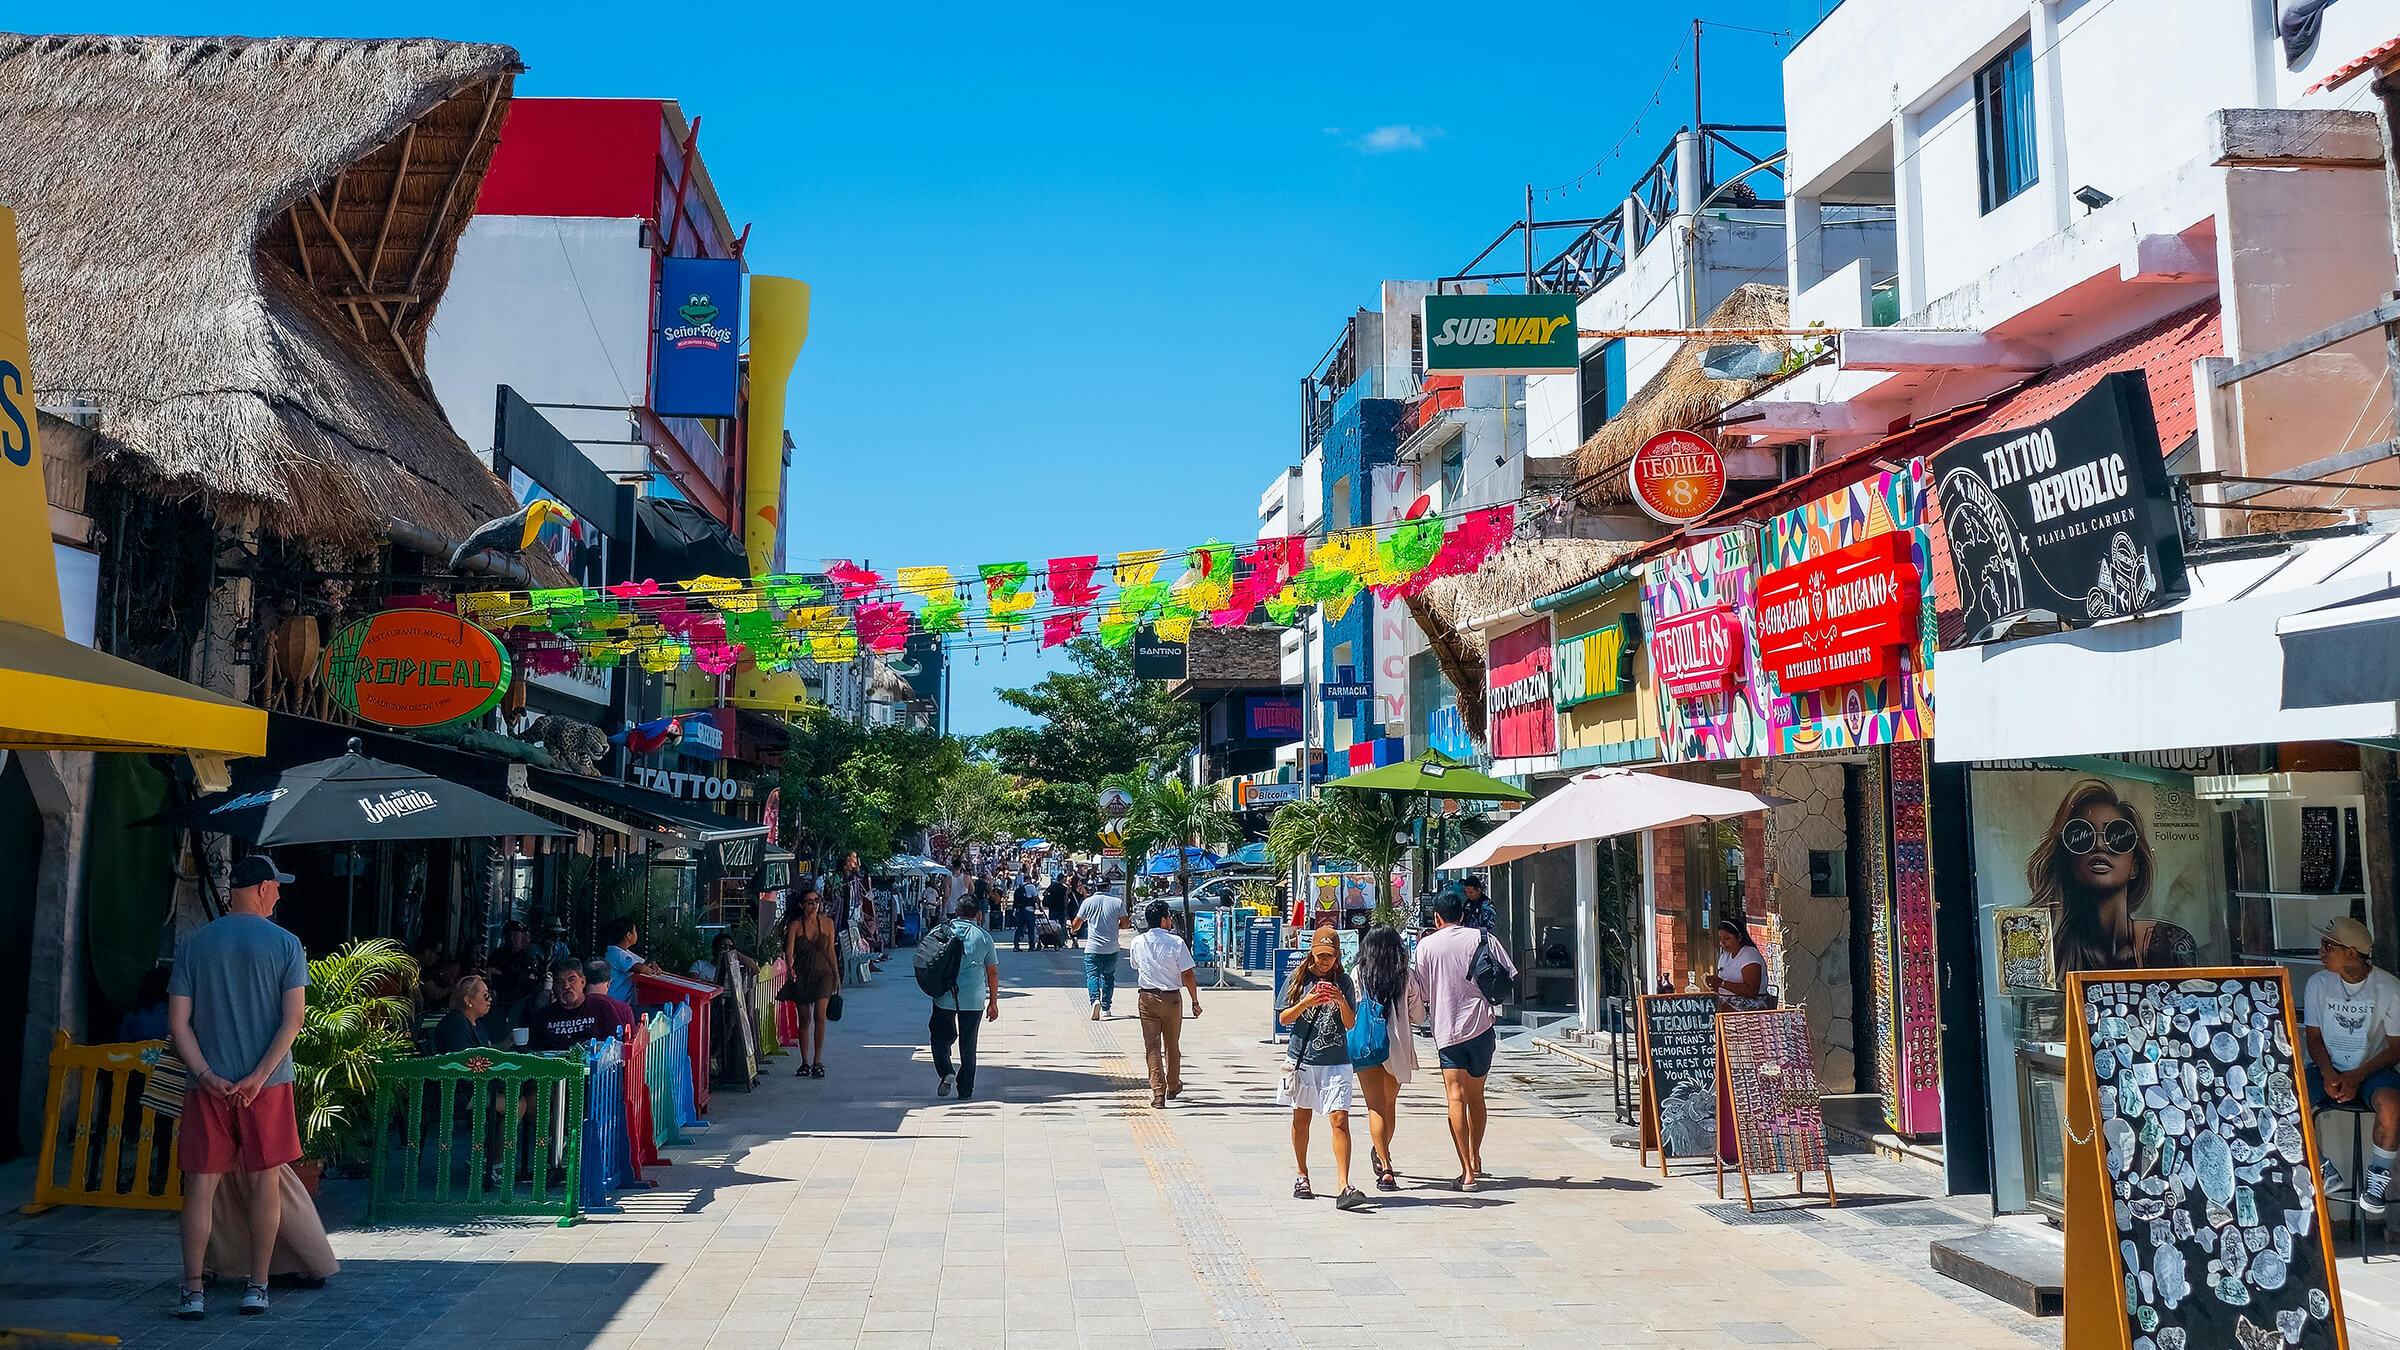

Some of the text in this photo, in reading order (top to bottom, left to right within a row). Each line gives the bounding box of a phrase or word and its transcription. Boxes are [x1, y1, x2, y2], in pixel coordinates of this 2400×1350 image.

[664, 323, 732, 343] Señor Frog's
[1433, 314, 1570, 347] SUBWAY
[0, 359, 31, 467] S
[1639, 454, 1718, 479] TEQUILA
[1982, 427, 2057, 490] TATTOO
[1673, 480, 1693, 506] 8
[2027, 453, 2128, 524] REPUBLIC
[1967, 477, 2009, 553] MEXICO
[2036, 507, 2136, 547] PLAYA DEL CARMEN
[1765, 573, 1888, 636] CORAZÓN MEXICANO
[1139, 647, 1182, 656] SANTINO
[1655, 614, 1724, 679] TEQUILA 8
[329, 655, 494, 689] TROPICAL
[1553, 626, 1625, 704] SUBWAY
[1327, 686, 1368, 696] FARMACIA
[633, 766, 738, 800] TATTOO
[357, 789, 435, 824] Bohemia
[1258, 791, 1288, 800] Bitcoin
[2155, 831, 2200, 841] Follow us
[1651, 999, 1716, 1013] HAKUNA
[2327, 1003, 2376, 1014] MINDSET
[547, 1017, 595, 1030] AMERICAN
[554, 1025, 585, 1035] EAGLE
[1652, 1014, 1717, 1031] TEQUILA
[1650, 1045, 1698, 1056] MEMORIES
[1664, 1033, 1717, 1046] IT MEANS N
[1656, 1057, 1717, 1069] THE REST OF
[1664, 1068, 1717, 1081] YOUR NIG
